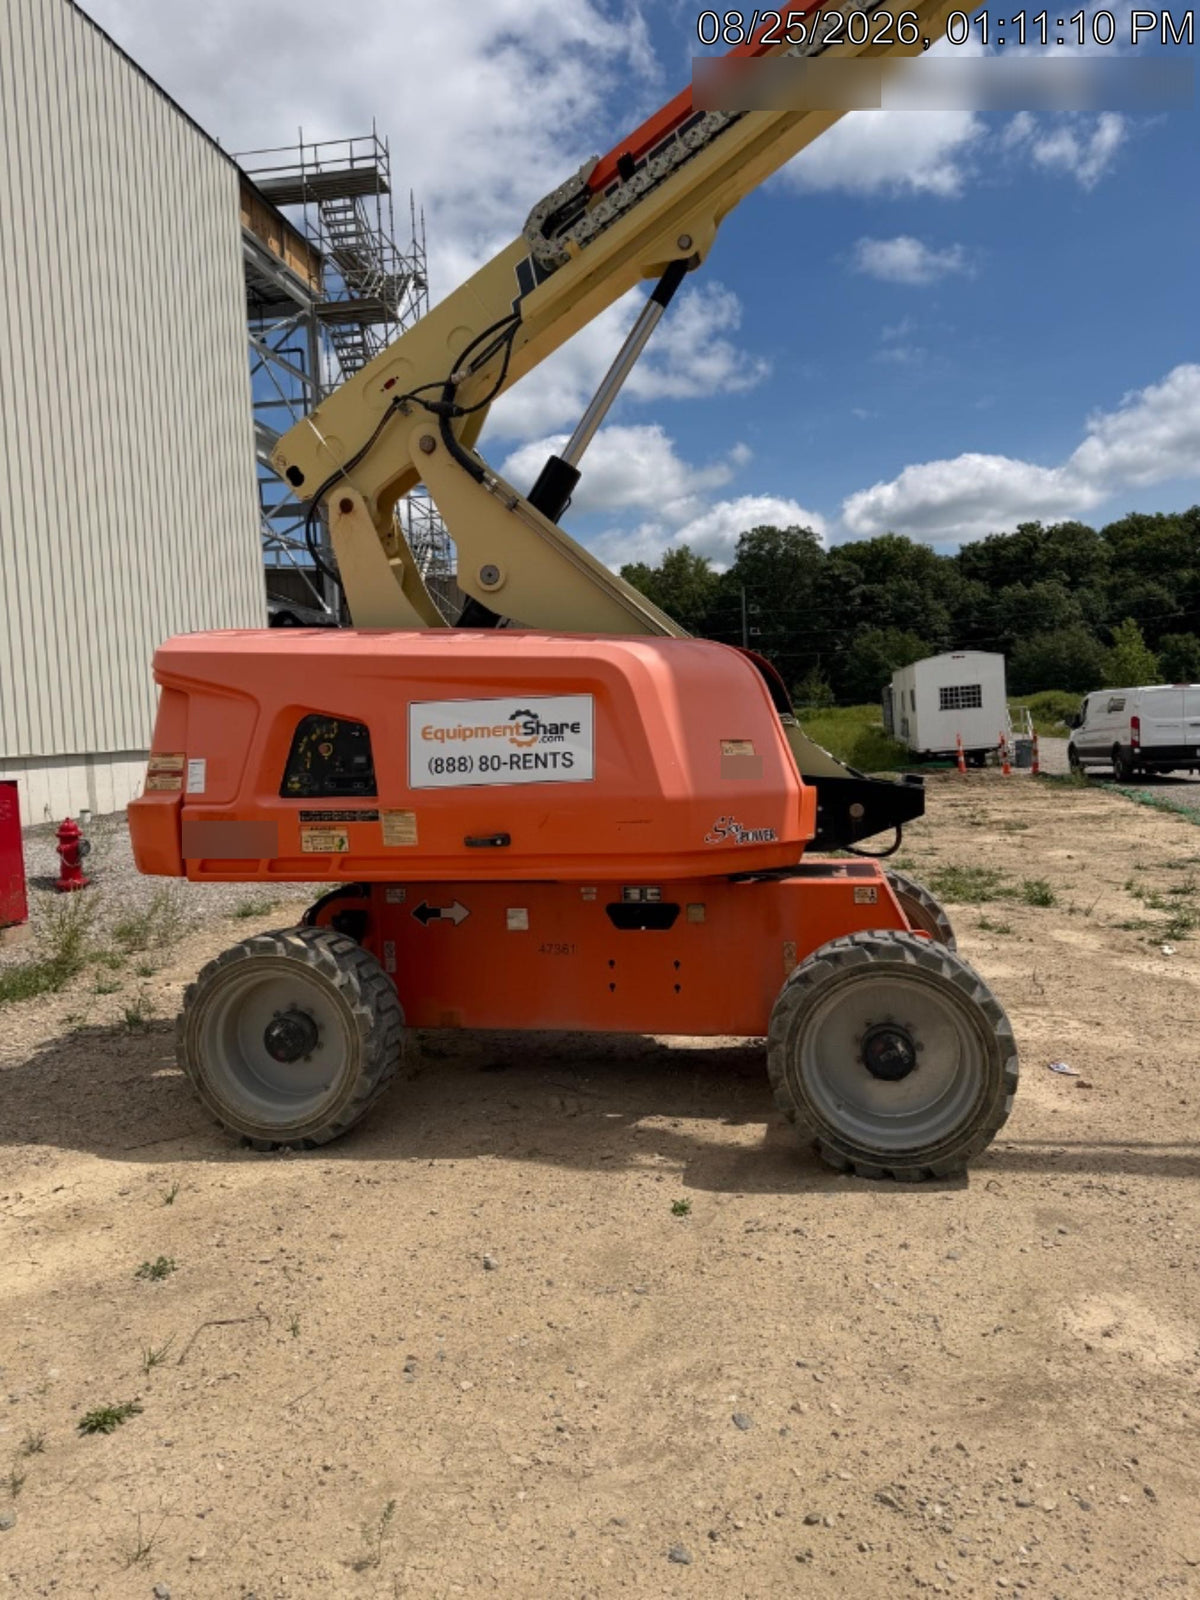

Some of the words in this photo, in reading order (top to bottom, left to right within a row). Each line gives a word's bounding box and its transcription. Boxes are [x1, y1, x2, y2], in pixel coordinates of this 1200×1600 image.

[421, 720, 581, 743] EquipmentShare
[428, 755, 474, 775] (888)
[478, 752, 574, 773] 80-RENTS
